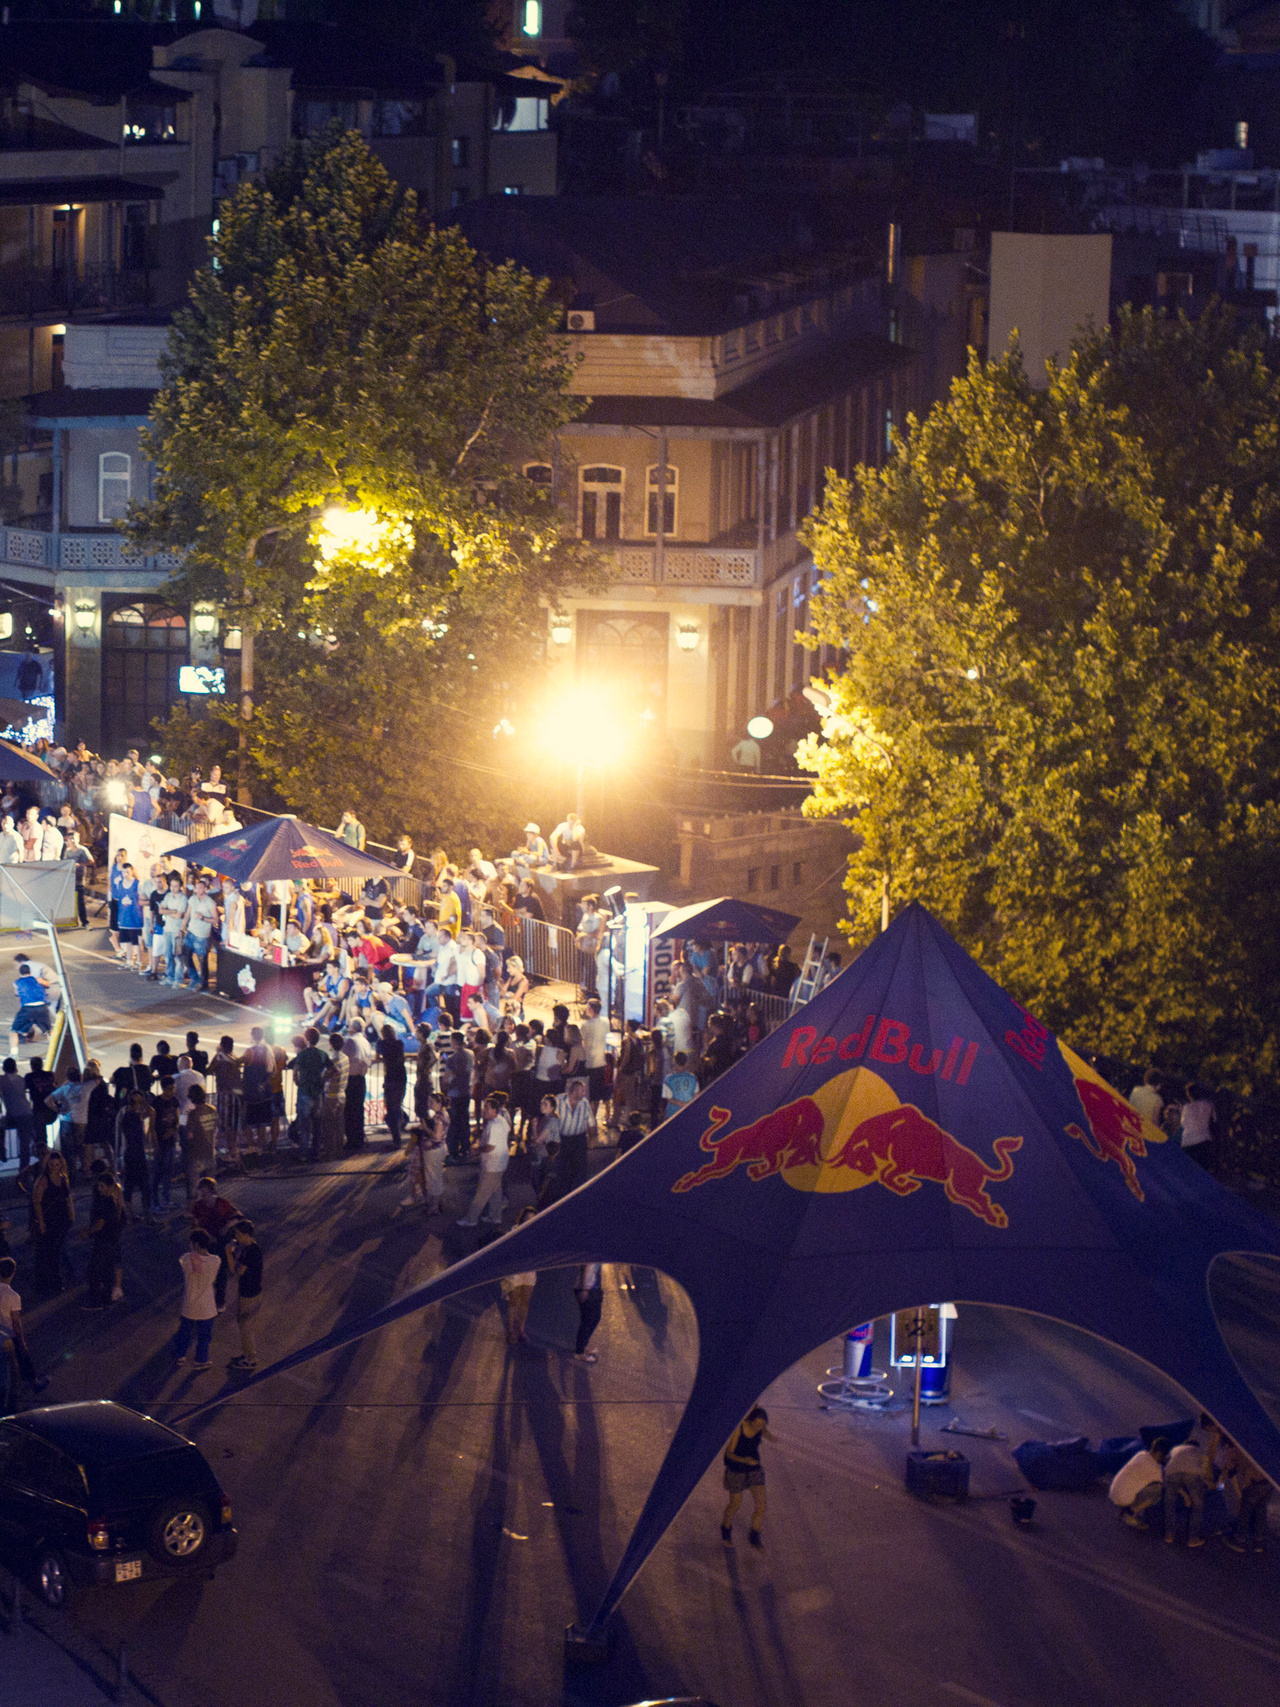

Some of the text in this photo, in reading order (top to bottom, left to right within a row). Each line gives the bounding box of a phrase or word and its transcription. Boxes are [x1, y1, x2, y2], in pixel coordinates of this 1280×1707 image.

[291, 858, 345, 869] Red Bull
[781, 1014, 979, 1086] Red Bull
